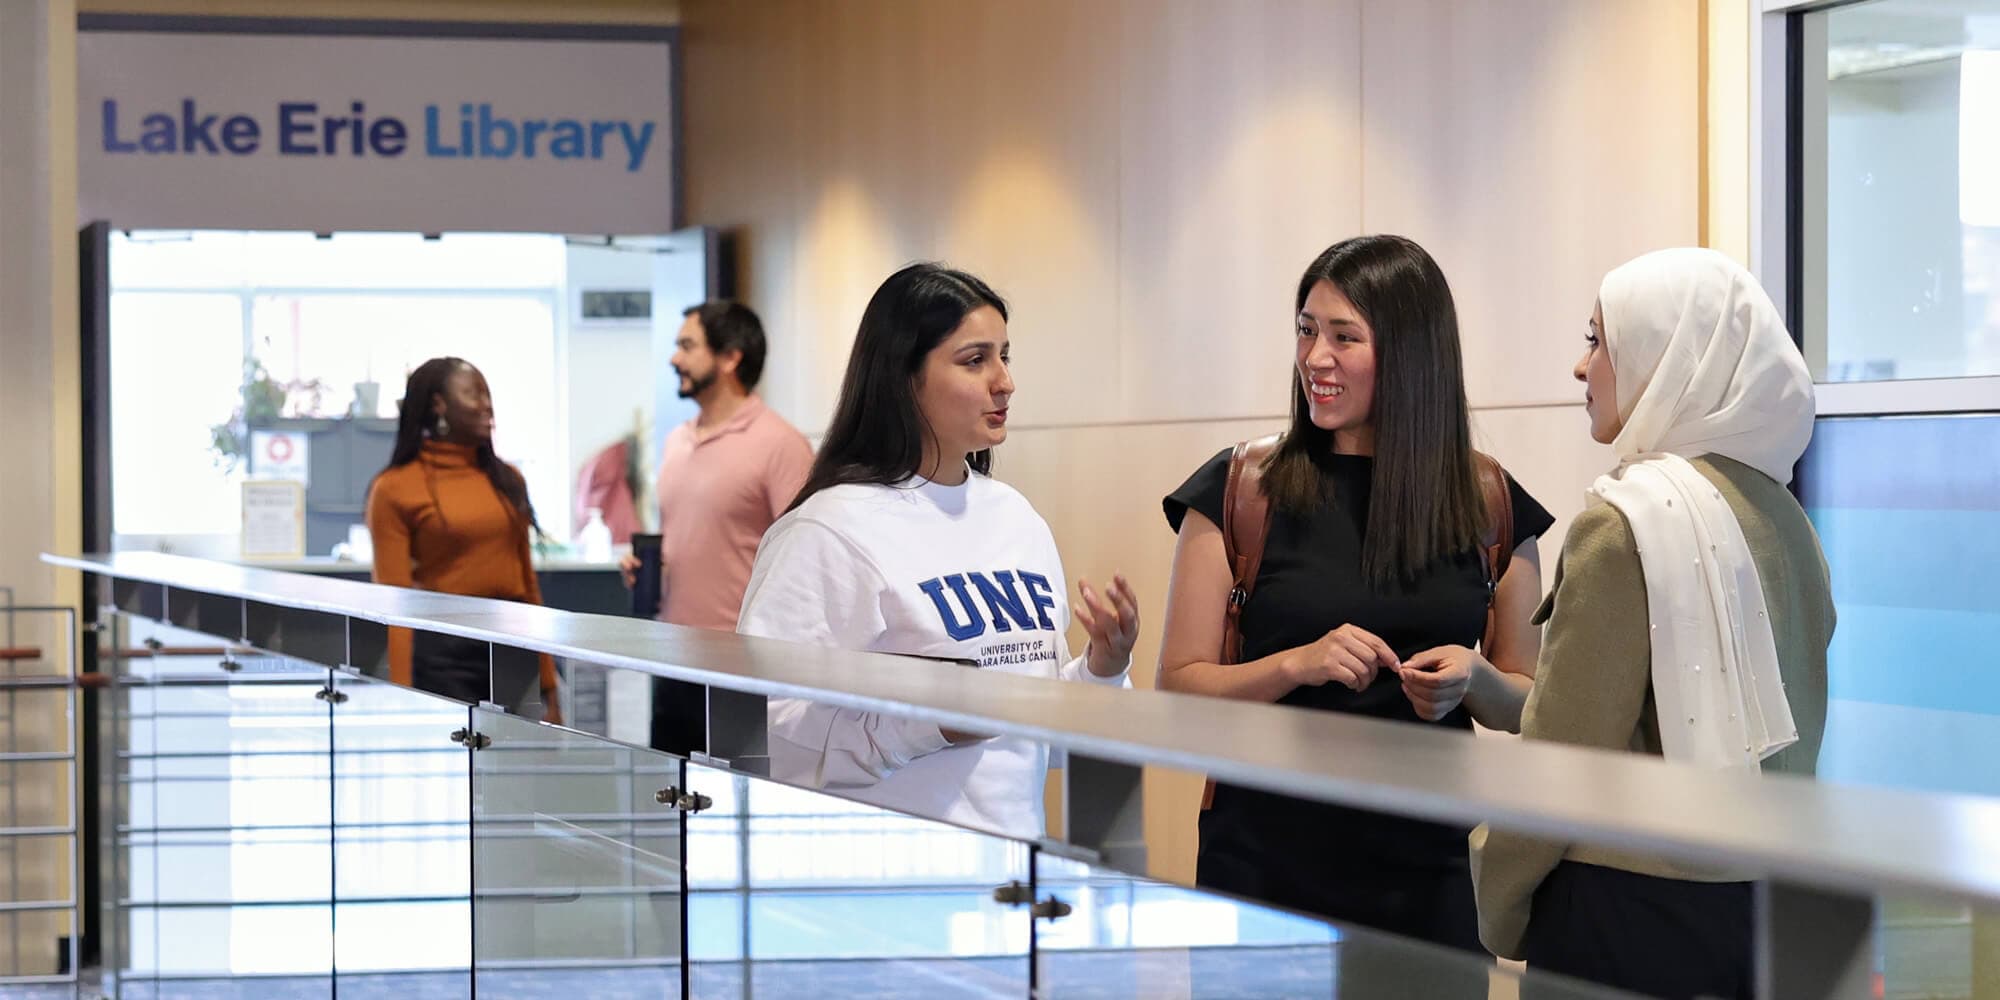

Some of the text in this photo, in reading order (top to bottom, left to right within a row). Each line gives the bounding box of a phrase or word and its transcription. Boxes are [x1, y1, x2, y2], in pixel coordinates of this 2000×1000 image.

[101, 98, 655, 171] Lake Erie Library
[918, 569, 1056, 642] UNF
[980, 640, 1044, 657] UNIVERSITY OF
[999, 654, 1026, 666] FALLS
